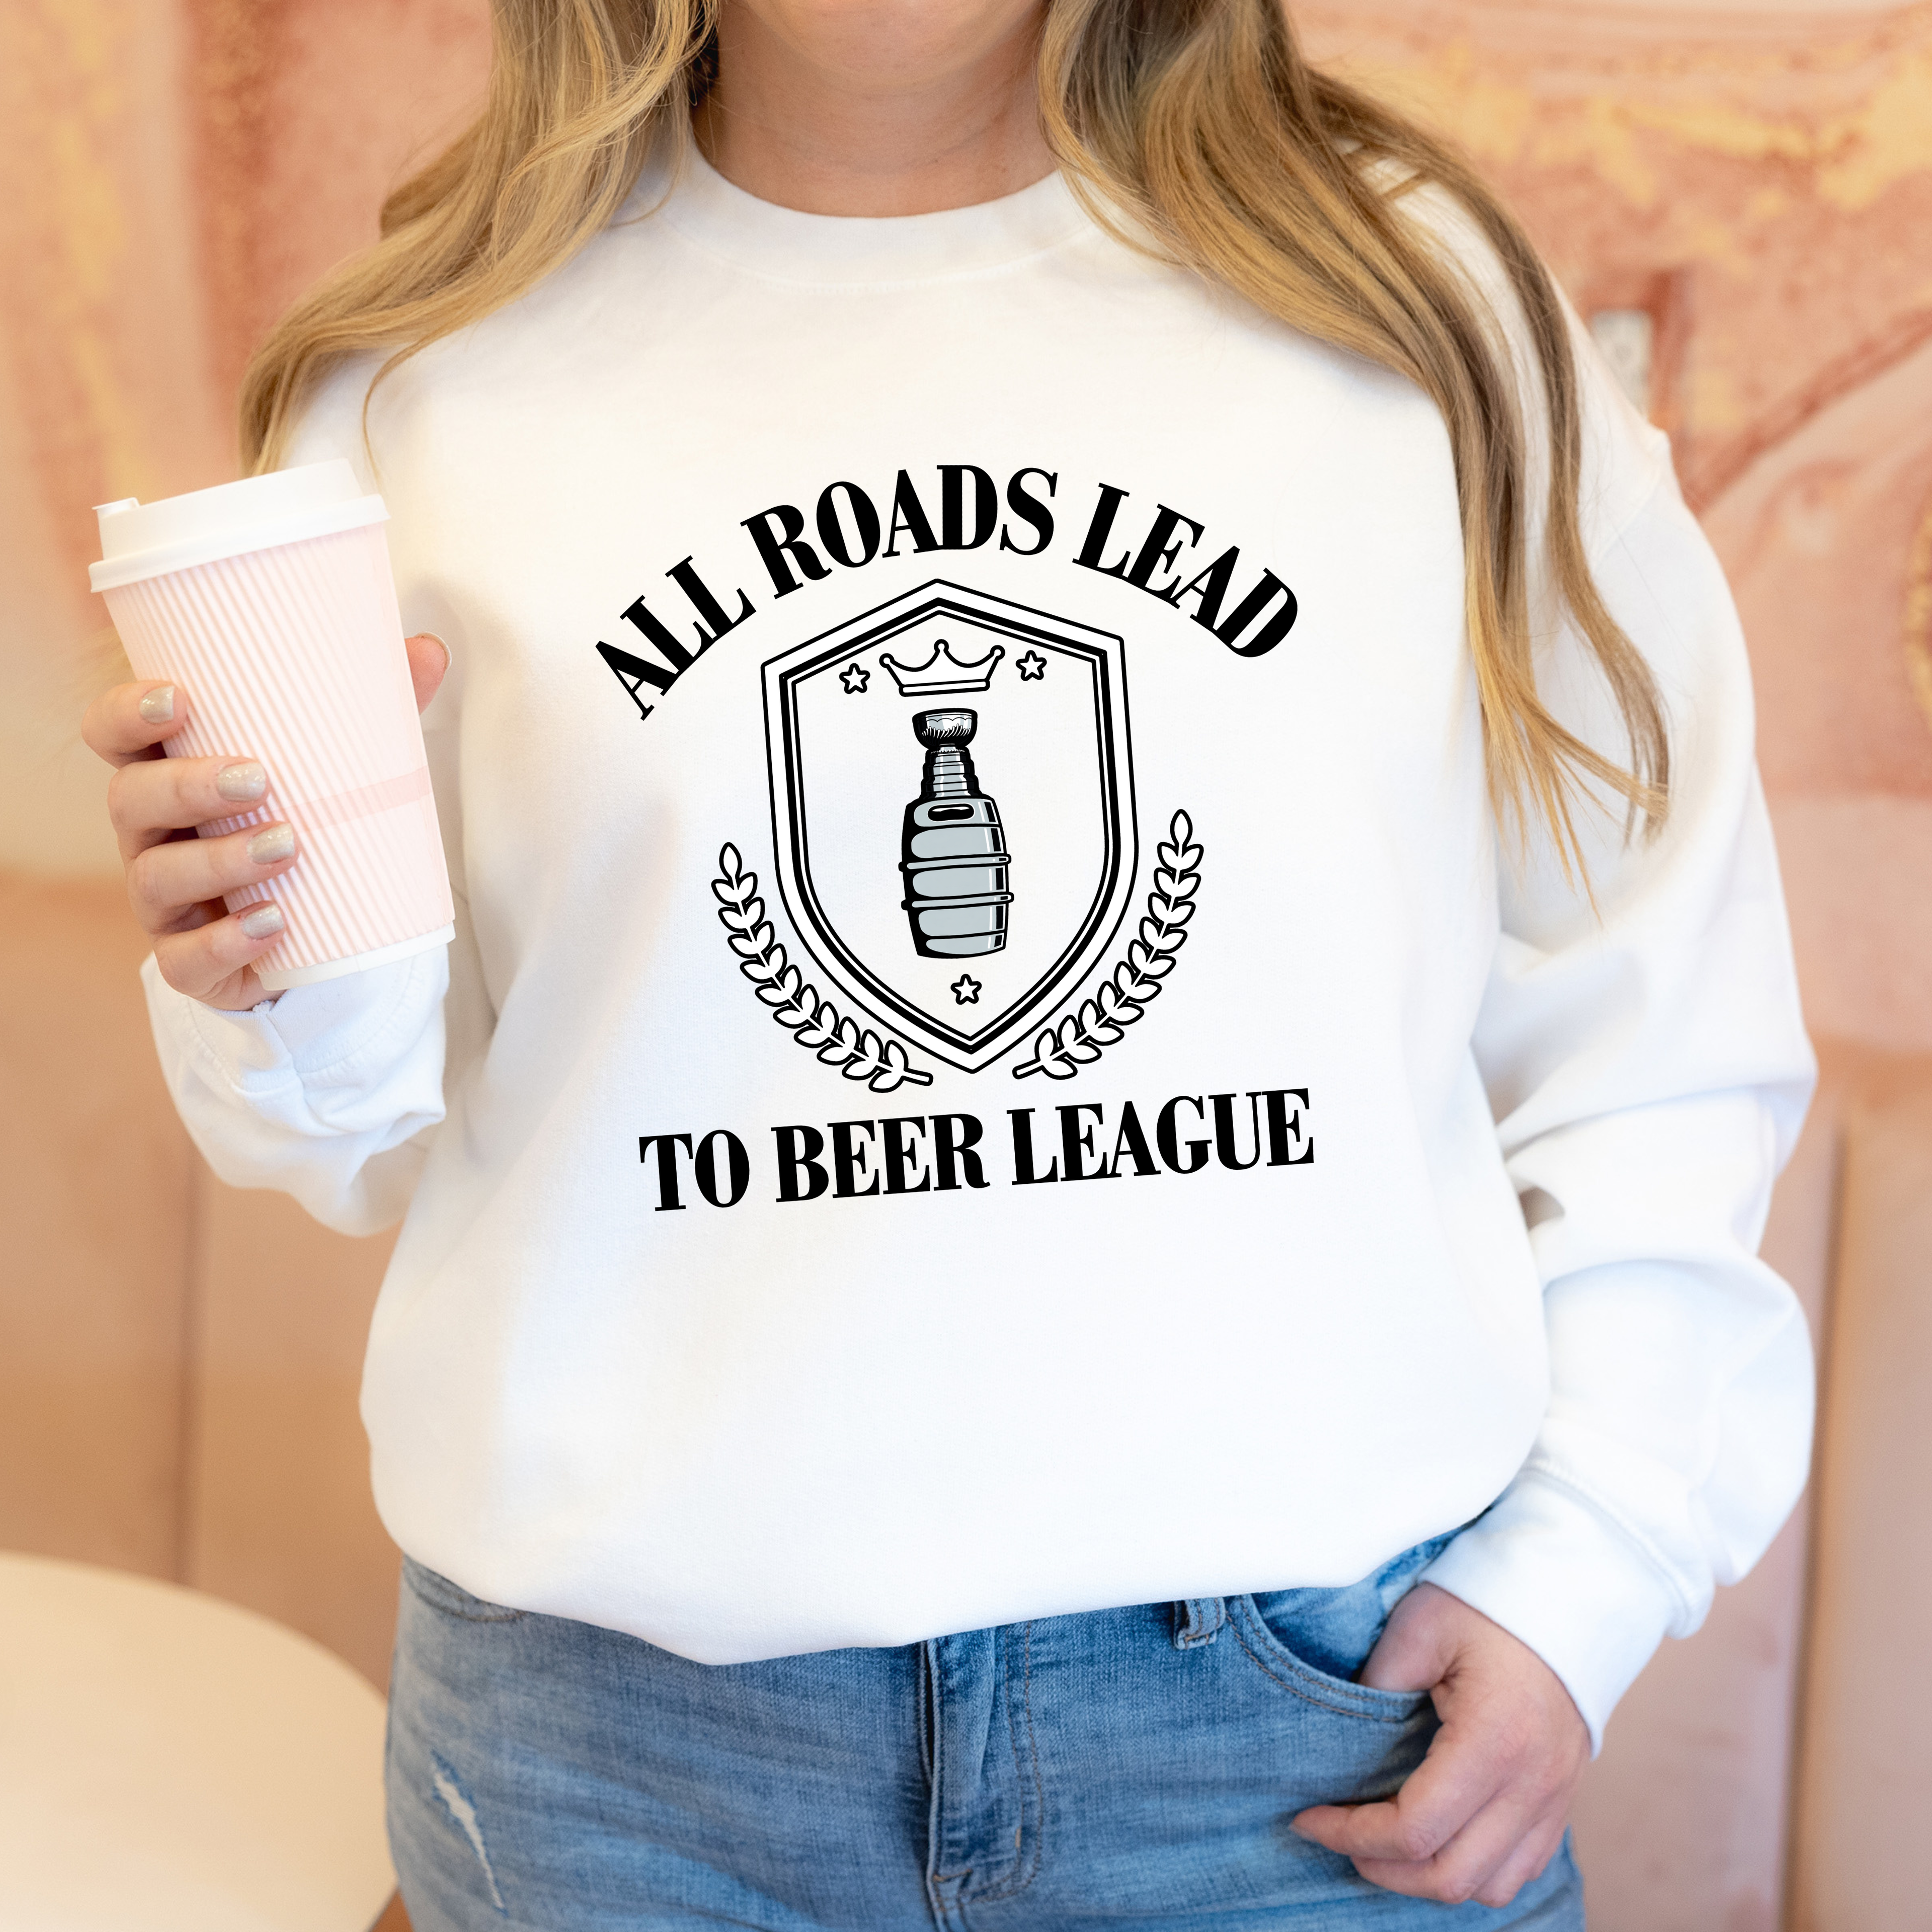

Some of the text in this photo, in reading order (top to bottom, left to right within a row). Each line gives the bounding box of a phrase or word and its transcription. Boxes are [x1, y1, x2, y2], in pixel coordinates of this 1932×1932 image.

[596, 465, 1298, 720] ALL ROADS LEAD
[639, 1088, 1314, 1211] TO BEER LEAGUE
